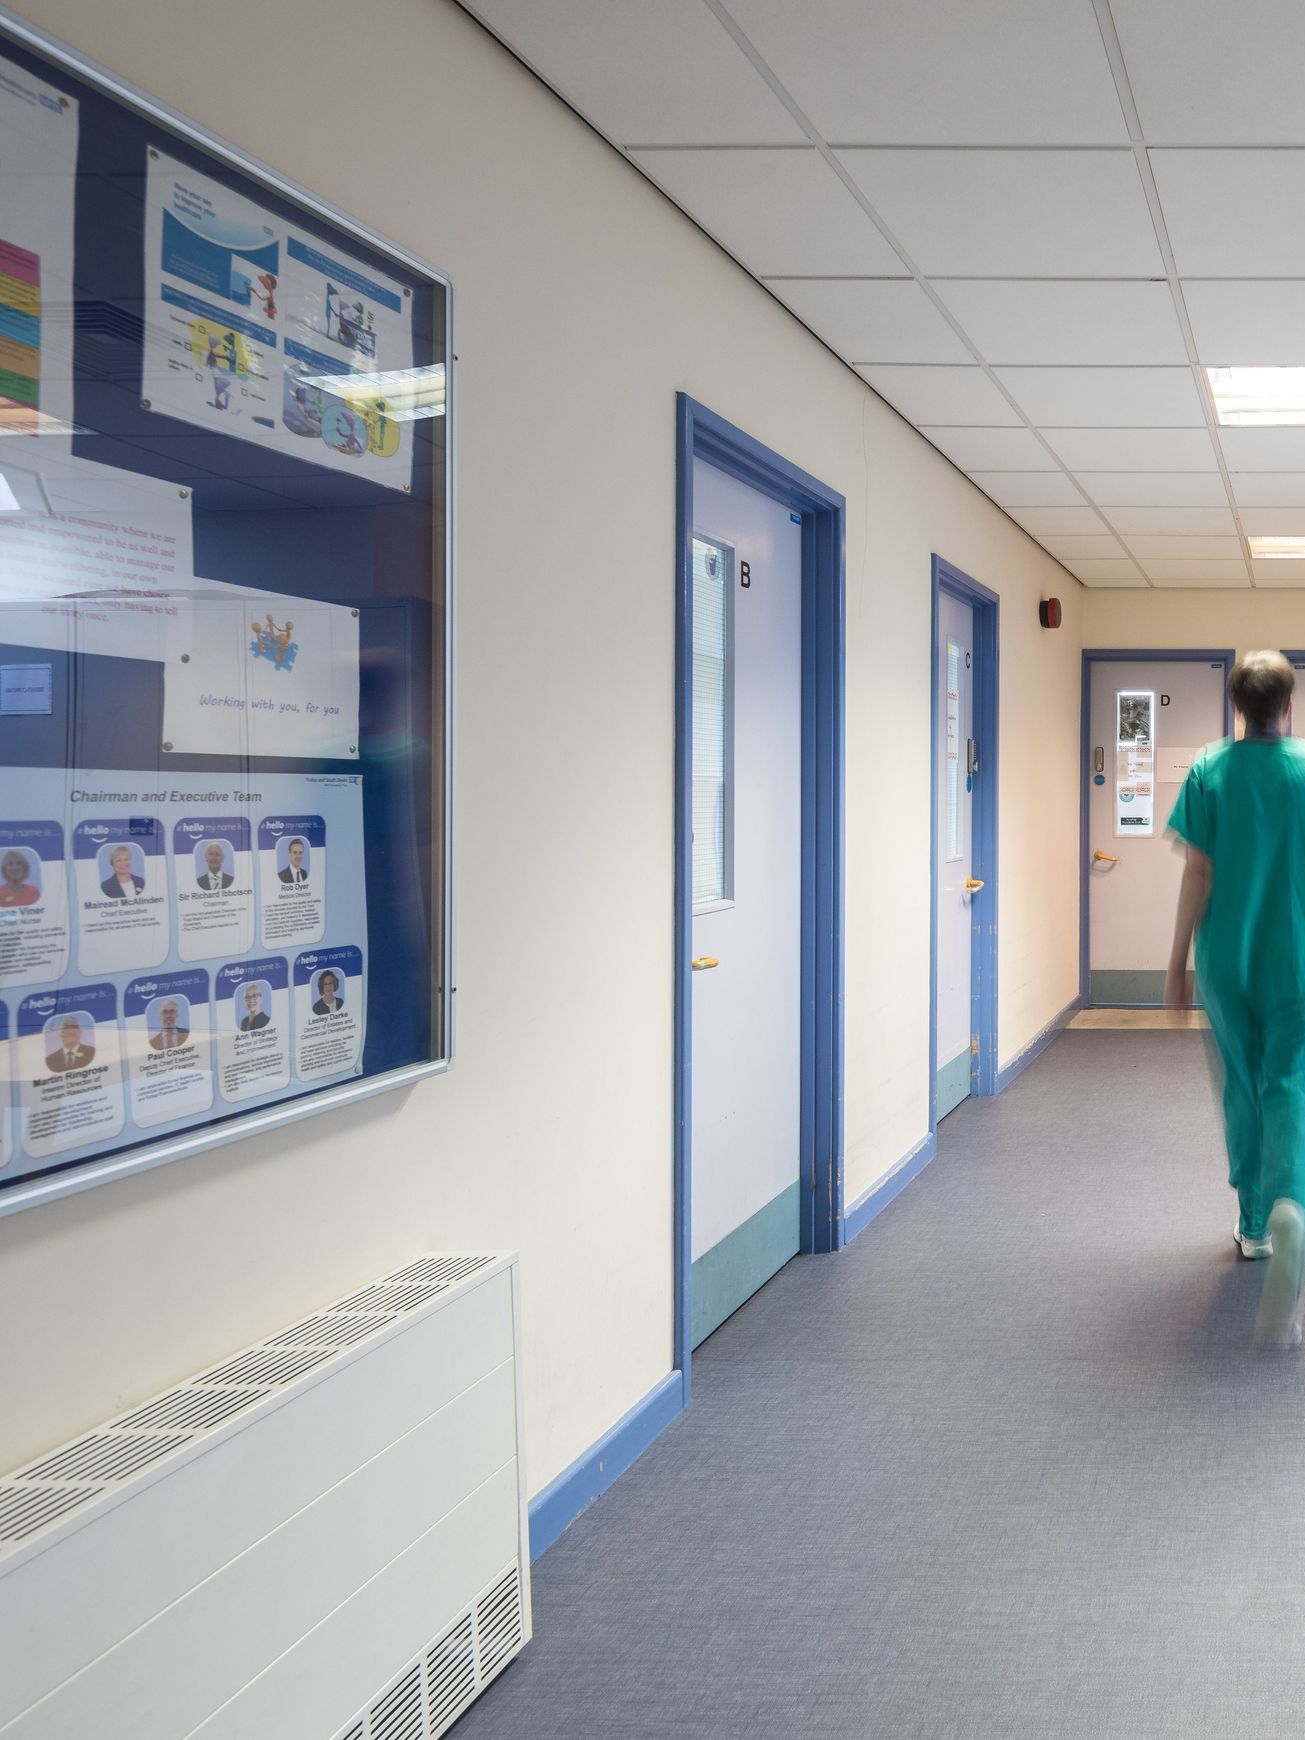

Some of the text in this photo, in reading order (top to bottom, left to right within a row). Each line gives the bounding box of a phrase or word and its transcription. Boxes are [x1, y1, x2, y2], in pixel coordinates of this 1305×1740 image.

[740, 560, 751, 588] B
[965, 651, 971, 669] C
[199, 694, 246, 710] Working
[251, 699, 274, 710] with
[305, 702, 320, 713] for
[323, 705, 340, 717] you
[1160, 694, 1171, 707] D
[70, 790, 262, 803] Chairman and Executive Team
[281, 882, 309, 892] Rob Dyer
[178, 889, 253, 901] Sir Richard Ibbotson
[84, 896, 164, 910] Mairead McAlinden
[19, 906, 46, 916] Viner
[100, 907, 148, 918] Chief Executive
[20, 917, 41, 925] Nurse
[308, 1012, 348, 1026] Lesley Darke
[235, 1028, 277, 1041] Ann Wagner
[147, 1046, 195, 1061] Paul Cooper
[33, 1065, 109, 1087] Martin Ringrose
